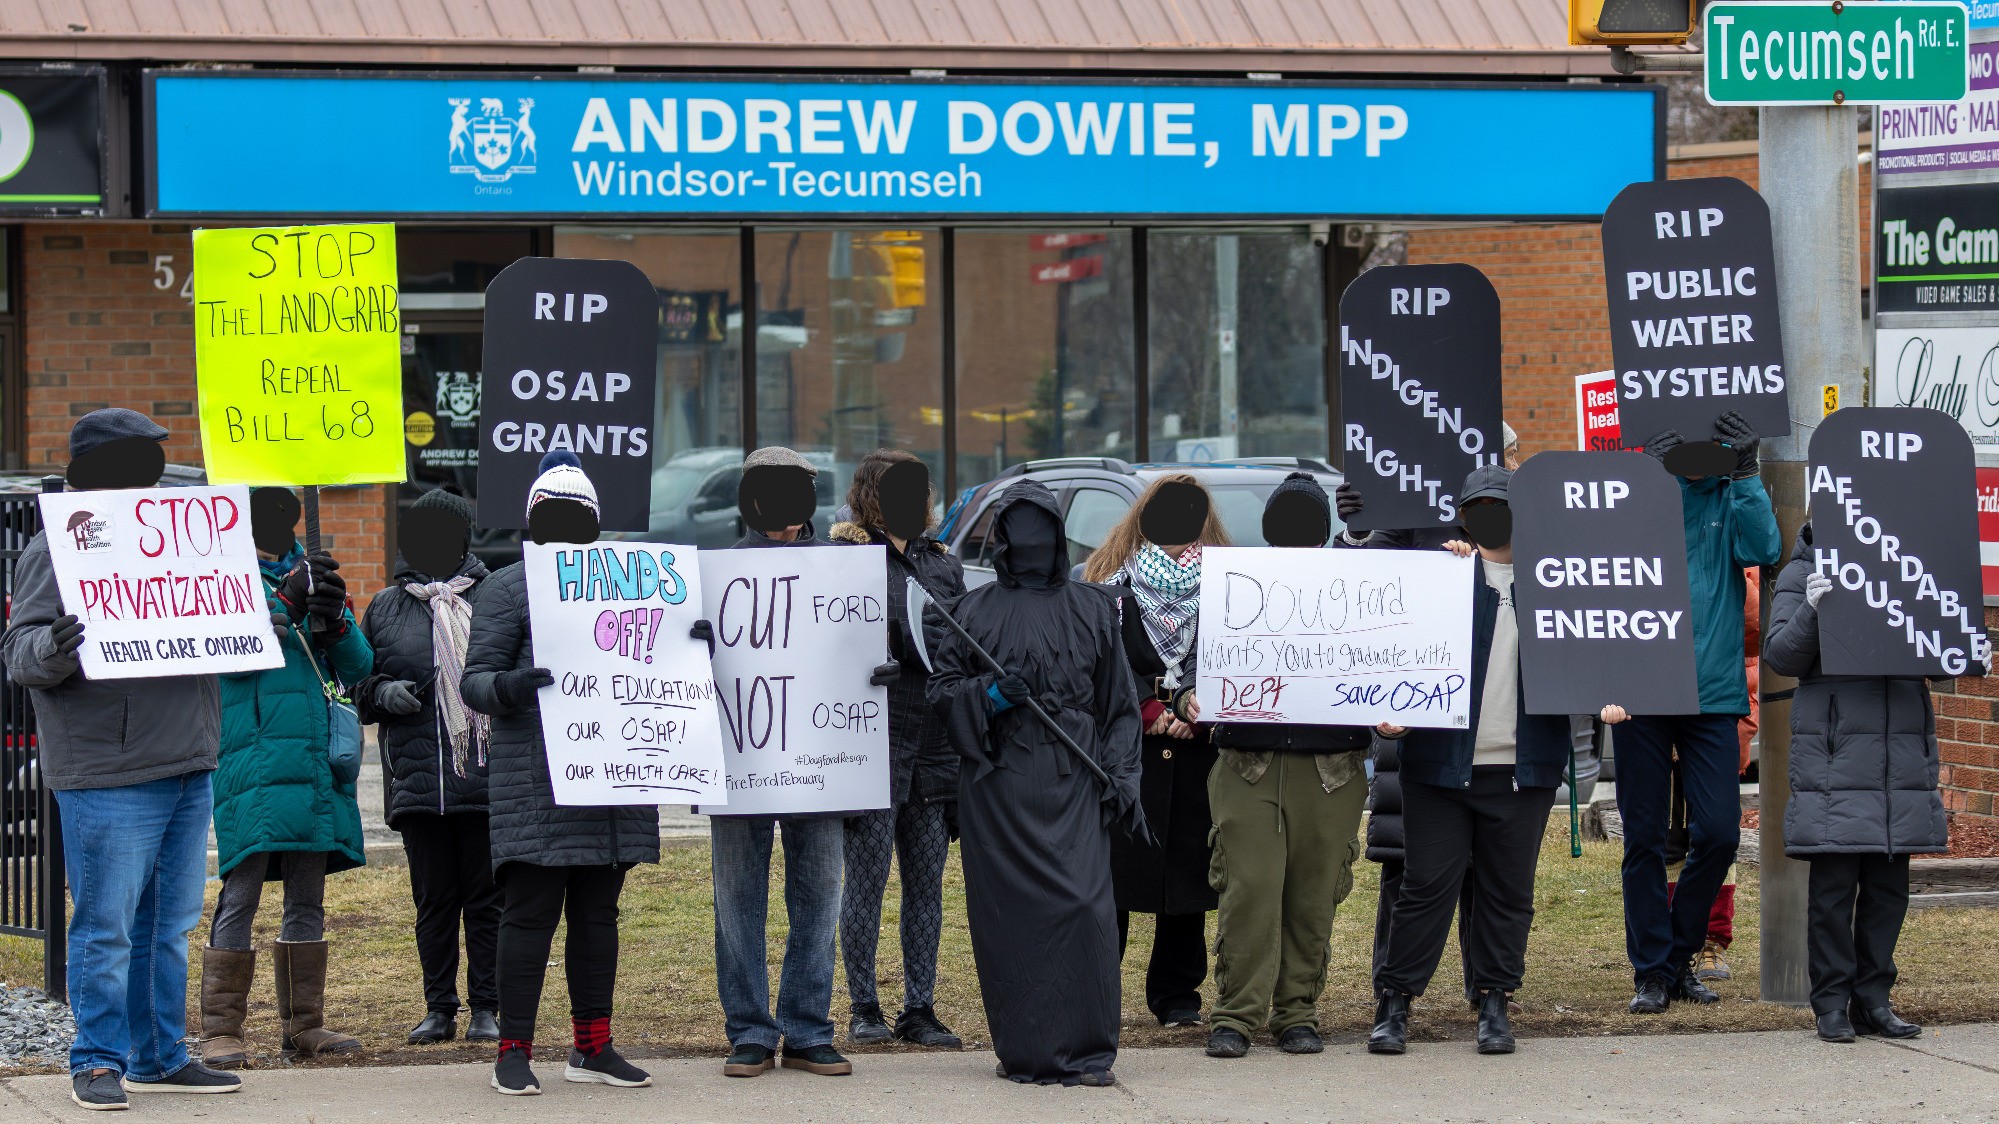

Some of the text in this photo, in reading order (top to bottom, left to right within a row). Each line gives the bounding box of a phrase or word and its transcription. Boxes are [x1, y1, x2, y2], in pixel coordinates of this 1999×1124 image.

[1713, 15, 1960, 81] Tecumseh Rd. E.
[1969, 52, 1993, 79] MO
[571, 97, 1409, 168] ANDREW DOWIE, MPP
[1882, 104, 1958, 140] PRINTING
[1879, 154, 1917, 169] PROMOTIONAL
[1918, 152, 1945, 167] PRODUCTS
[1949, 150, 1969, 165] SOCIAL
[1969, 149, 1986, 163] MEDIA
[474, 184, 512, 195] Ontario
[572, 160, 982, 197] Windsor-Tecumseh
[1654, 208, 1724, 239] RIP
[248, 231, 375, 279] STOP
[1883, 216, 1999, 267] The Gam
[1626, 266, 1757, 300] PUBLIC
[1916, 285, 1995, 303] VIDEO GAME SALES &
[199, 300, 255, 337] THE
[535, 292, 608, 323] RIP
[1391, 287, 1451, 316] RIP
[1631, 314, 1755, 348] WATER
[261, 358, 352, 396] REPEAL
[511, 369, 632, 402] OSAP
[1622, 364, 1785, 400] SYSTEMS
[225, 400, 374, 442] BILL 68
[420, 448, 466, 458] ANDREW
[492, 421, 648, 457] GRANTS
[1860, 430, 1923, 461] RIP
[1346, 423, 1456, 522] RIGHTS
[1563, 480, 1630, 509] RIP
[1976, 486, 1999, 513] rid
[135, 495, 239, 558] STOP
[556, 548, 688, 605] HANDS
[1535, 557, 1663, 588] GREEN
[1811, 465, 1987, 661] AFFORDABLE
[718, 574, 884, 649] CUT FORD.
[1224, 571, 1348, 633] Doug
[1814, 548, 1967, 675] HOUSING
[594, 607, 664, 664] OFF!
[1535, 609, 1683, 640] ENERGY
[99, 635, 264, 663] HEALTH CARE ONTARIO
[1314, 642, 1335, 669] to
[1338, 643, 1411, 672] graduate
[1415, 640, 1451, 667] with
[561, 671, 601, 698] OUR
[1390, 674, 1466, 713] OSAP
[567, 716, 687, 744] OUR OSAP!
[714, 675, 879, 754] NOT OSAP.
[565, 763, 595, 780] OUR
[604, 762, 664, 782] HEALTH
